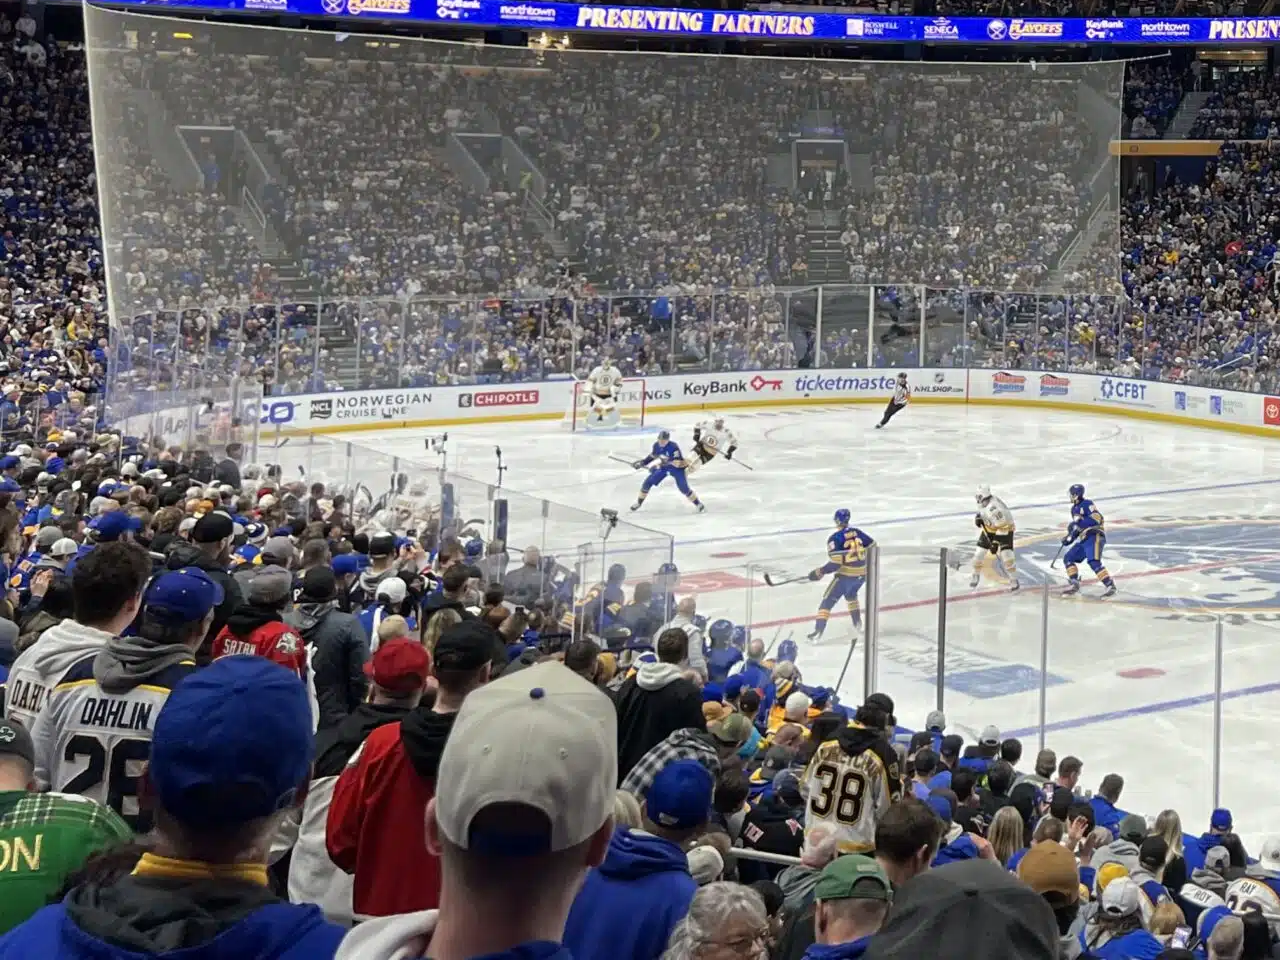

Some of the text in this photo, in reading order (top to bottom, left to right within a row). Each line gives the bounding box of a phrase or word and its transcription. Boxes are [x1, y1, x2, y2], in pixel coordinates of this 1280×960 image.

[501, 4, 556, 17] northtown
[576, 6, 815, 36] PRESENTING PARTNERS
[1009, 22, 1064, 36] PLAYOFFS
[1086, 19, 1124, 30] KeyBank
[1141, 22, 1190, 33] northtown
[924, 25, 959, 35] SENECA
[683, 378, 747, 396] KeyBank
[795, 374, 897, 392] ticketmaste
[475, 391, 537, 407] CHIPOTLE
[1115, 382, 1148, 401] CFBT
[310, 400, 332, 414] NCL
[336, 393, 432, 409] NORWEGIAN
[336, 406, 409, 420] CRUISE LINE
[223, 638, 257, 656] SATAN
[80, 697, 154, 730] DAHLIN
[810, 762, 866, 825] 38
[1240, 881, 1258, 895] RAY
